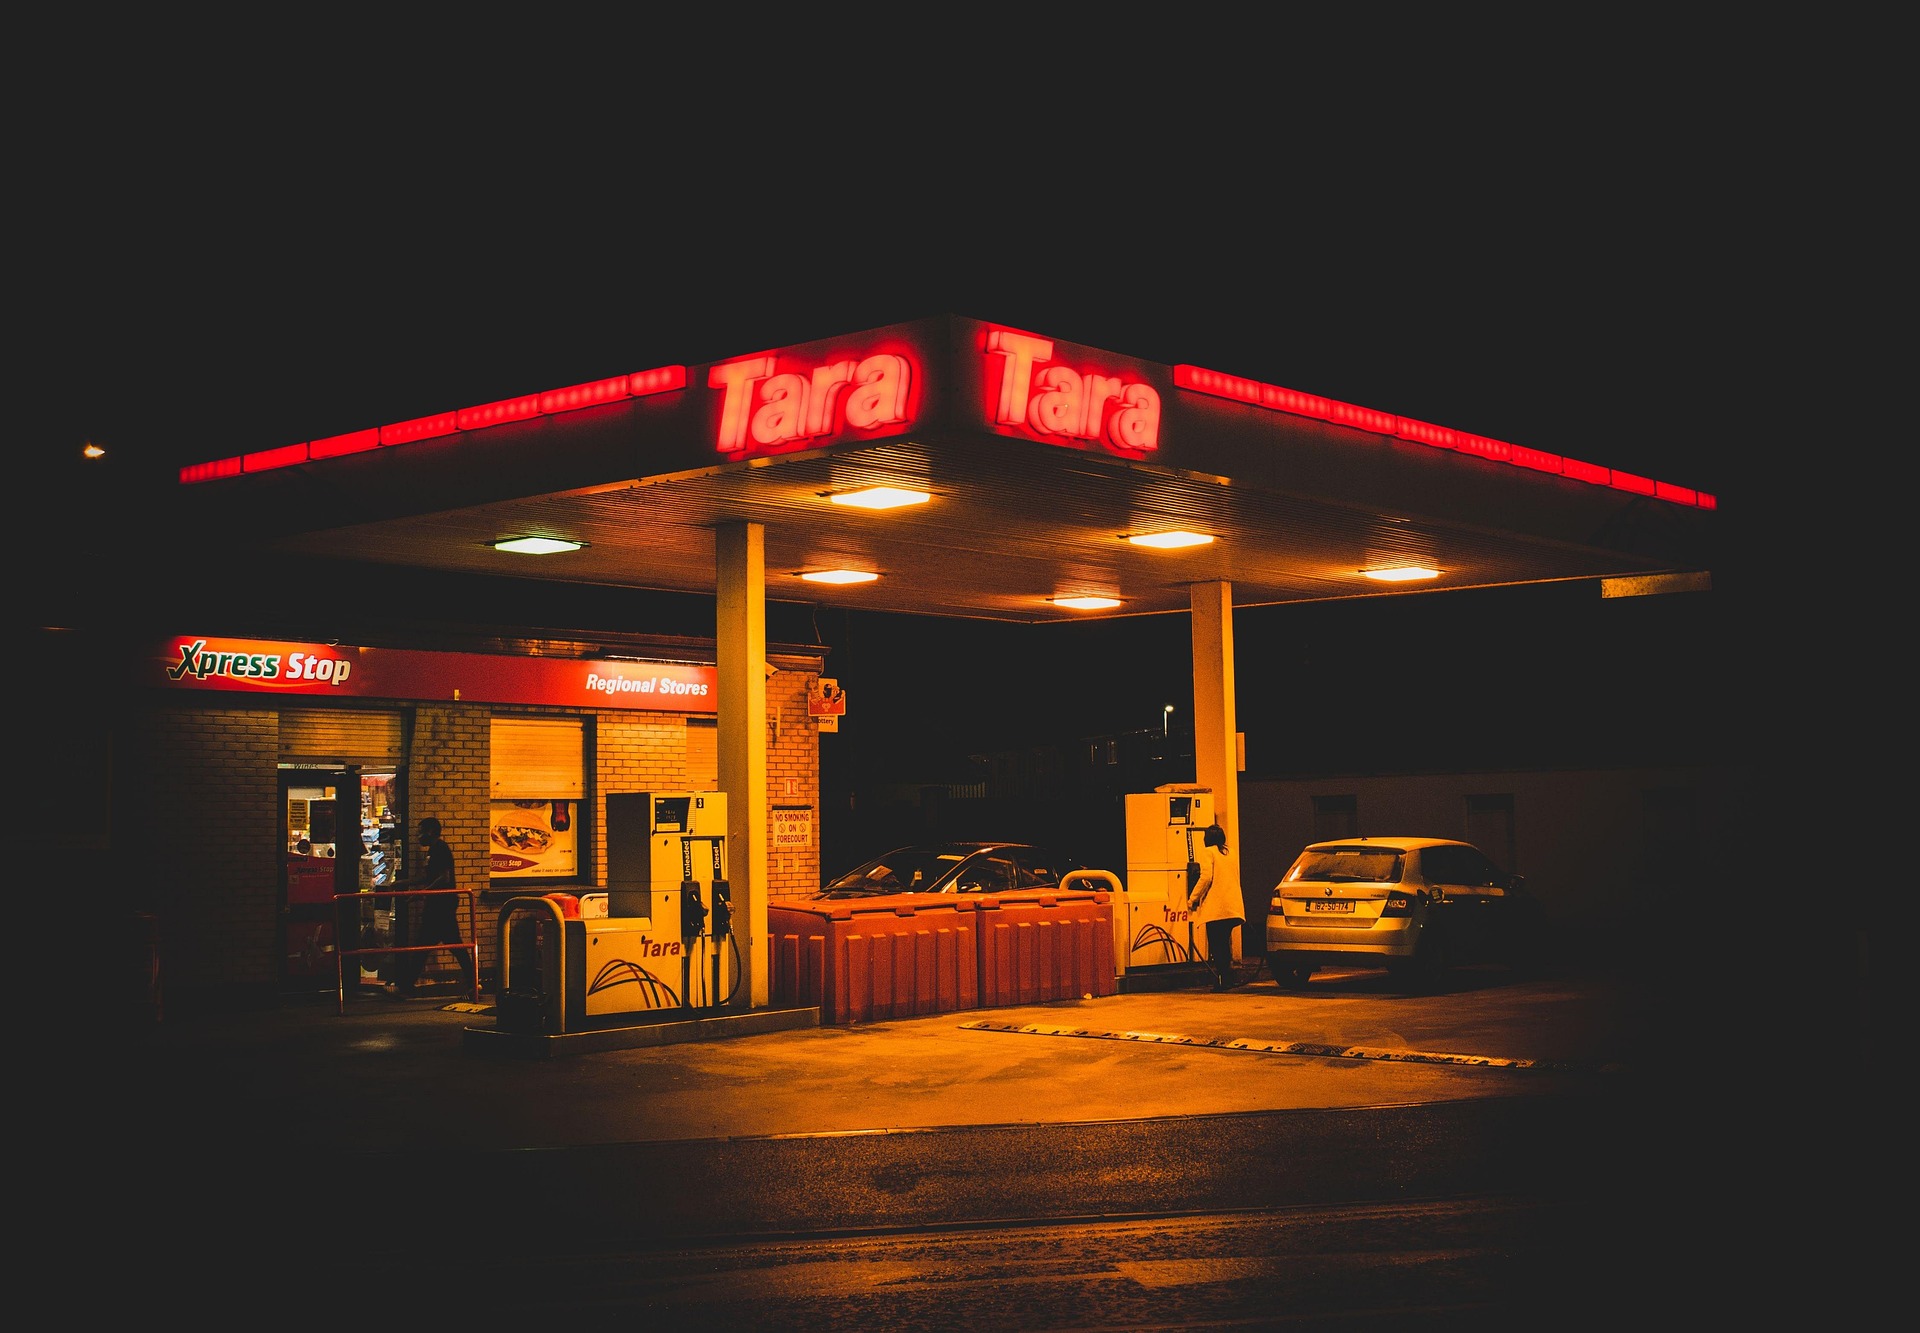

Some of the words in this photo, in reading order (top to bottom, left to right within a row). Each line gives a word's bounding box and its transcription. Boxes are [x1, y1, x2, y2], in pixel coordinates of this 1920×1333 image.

[985, 330, 1162, 451] Tara
[708, 354, 914, 453] Tara
[166, 639, 281, 681] Xpress
[285, 652, 351, 686] Stop
[585, 673, 657, 695] Regional
[659, 677, 708, 696] Stores
[818, 718, 835, 726] ottery
[698, 798, 703, 808] 3
[775, 813, 784, 822] NO
[784, 813, 810, 822] SMOKING
[788, 824, 797, 832] ON
[776, 834, 808, 843] FORECOURT
[491, 860, 508, 868] press
[683, 840, 691, 877] Unleaded
[1164, 908, 1188, 922] Tara
[642, 939, 681, 958] Tara
